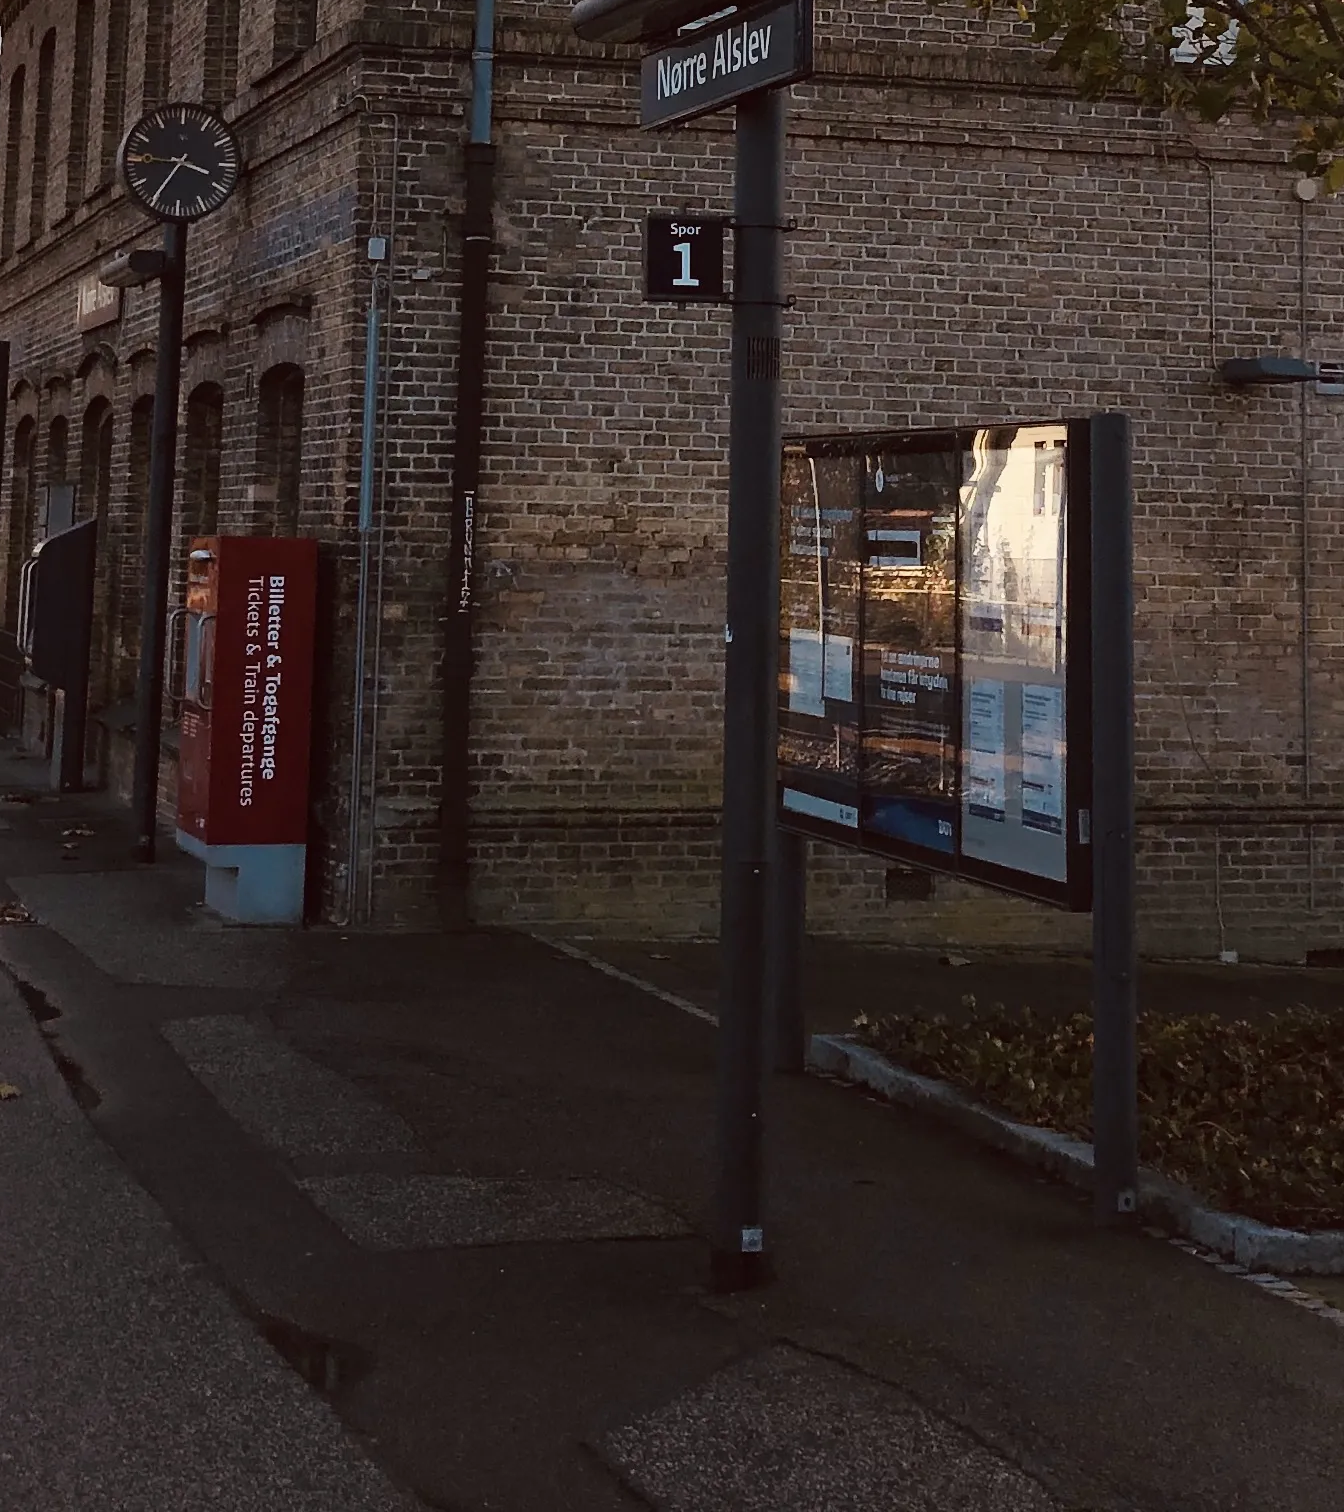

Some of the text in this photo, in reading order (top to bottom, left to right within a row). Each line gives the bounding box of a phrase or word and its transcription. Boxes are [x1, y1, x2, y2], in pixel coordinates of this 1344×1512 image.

[657, 21, 772, 100] Nørre Alslev
[670, 222, 702, 238] Spor
[672, 242, 700, 287] 1
[239, 575, 264, 807] Tickets & Train departures
[259, 576, 285, 780] Billetter & Togafgange
